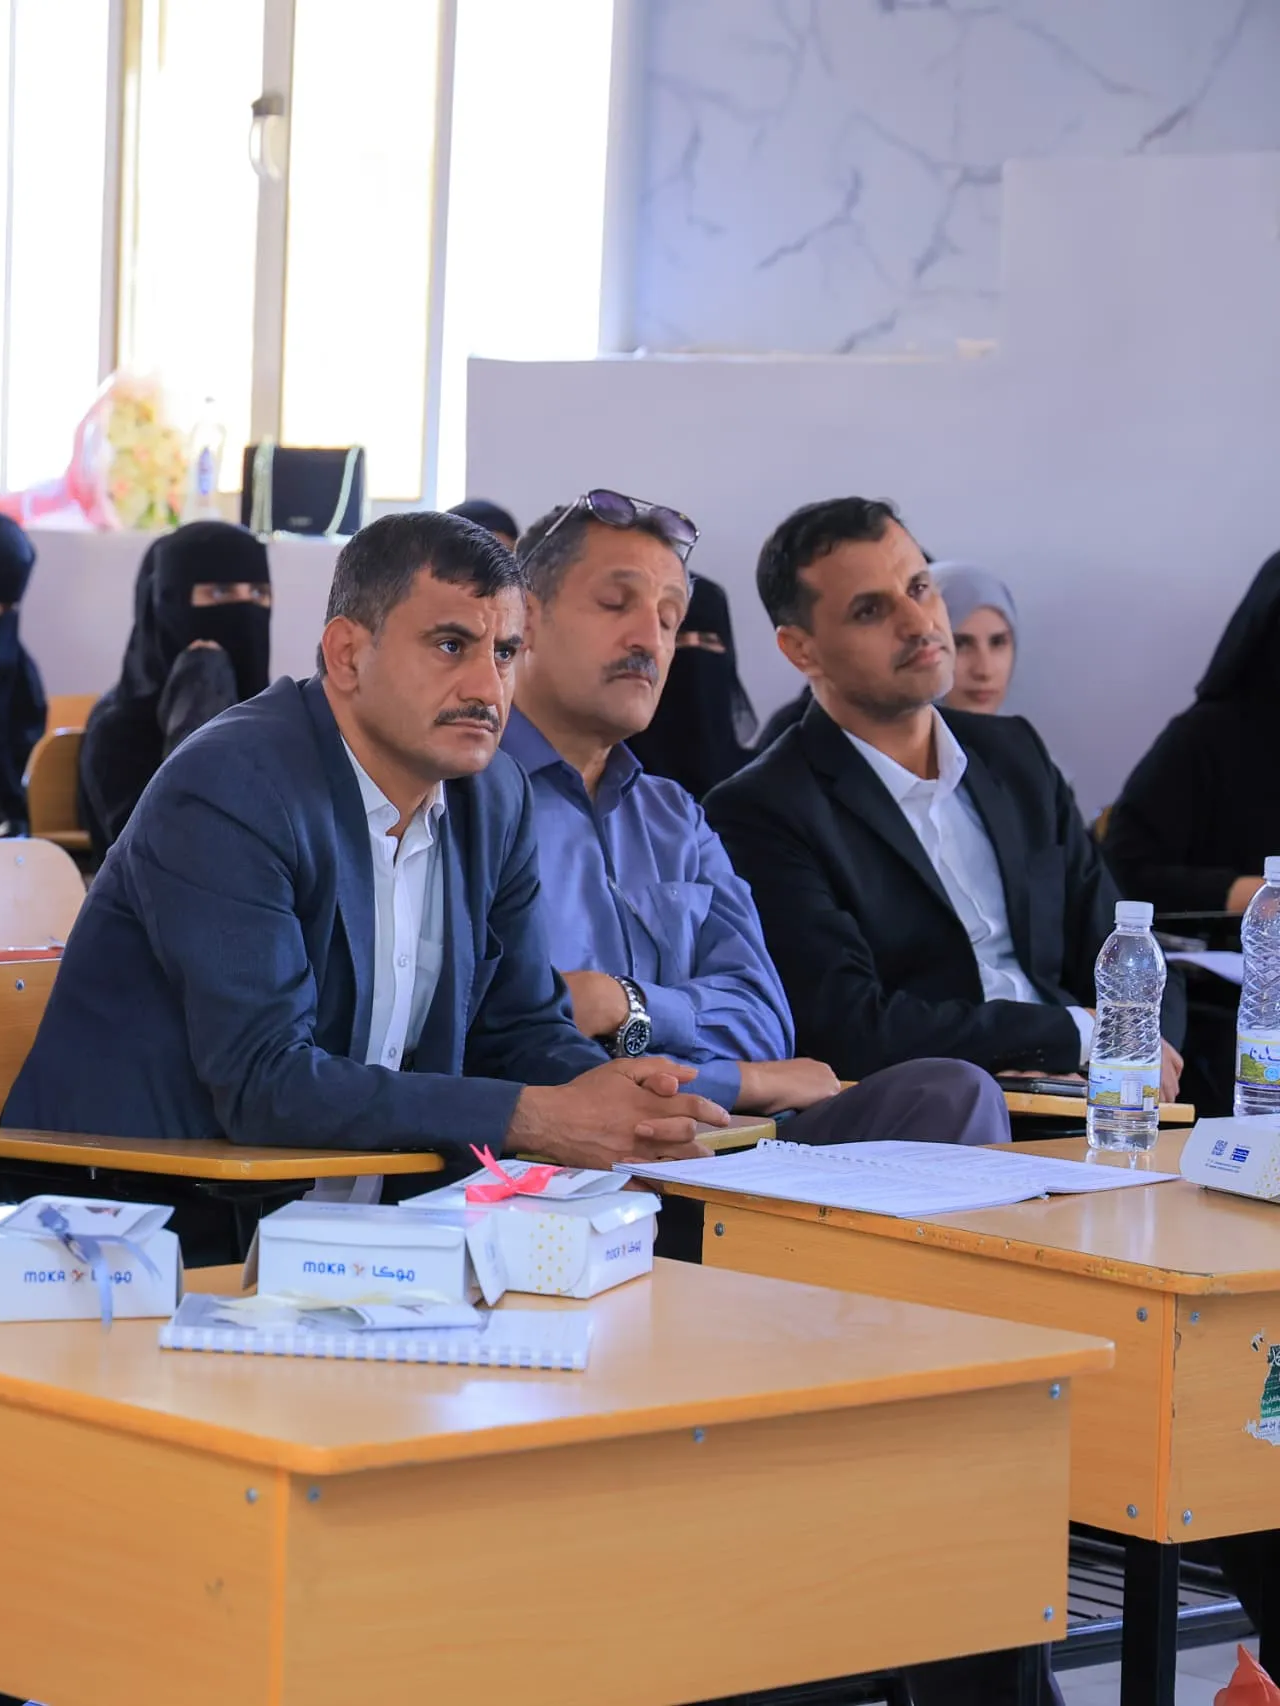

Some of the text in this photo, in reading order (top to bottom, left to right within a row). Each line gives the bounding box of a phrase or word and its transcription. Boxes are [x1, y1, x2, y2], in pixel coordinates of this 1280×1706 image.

[303, 1261, 346, 1275] MOKA
[372, 1265, 415, 1282] موكا
[24, 1270, 66, 1283] MOKA
